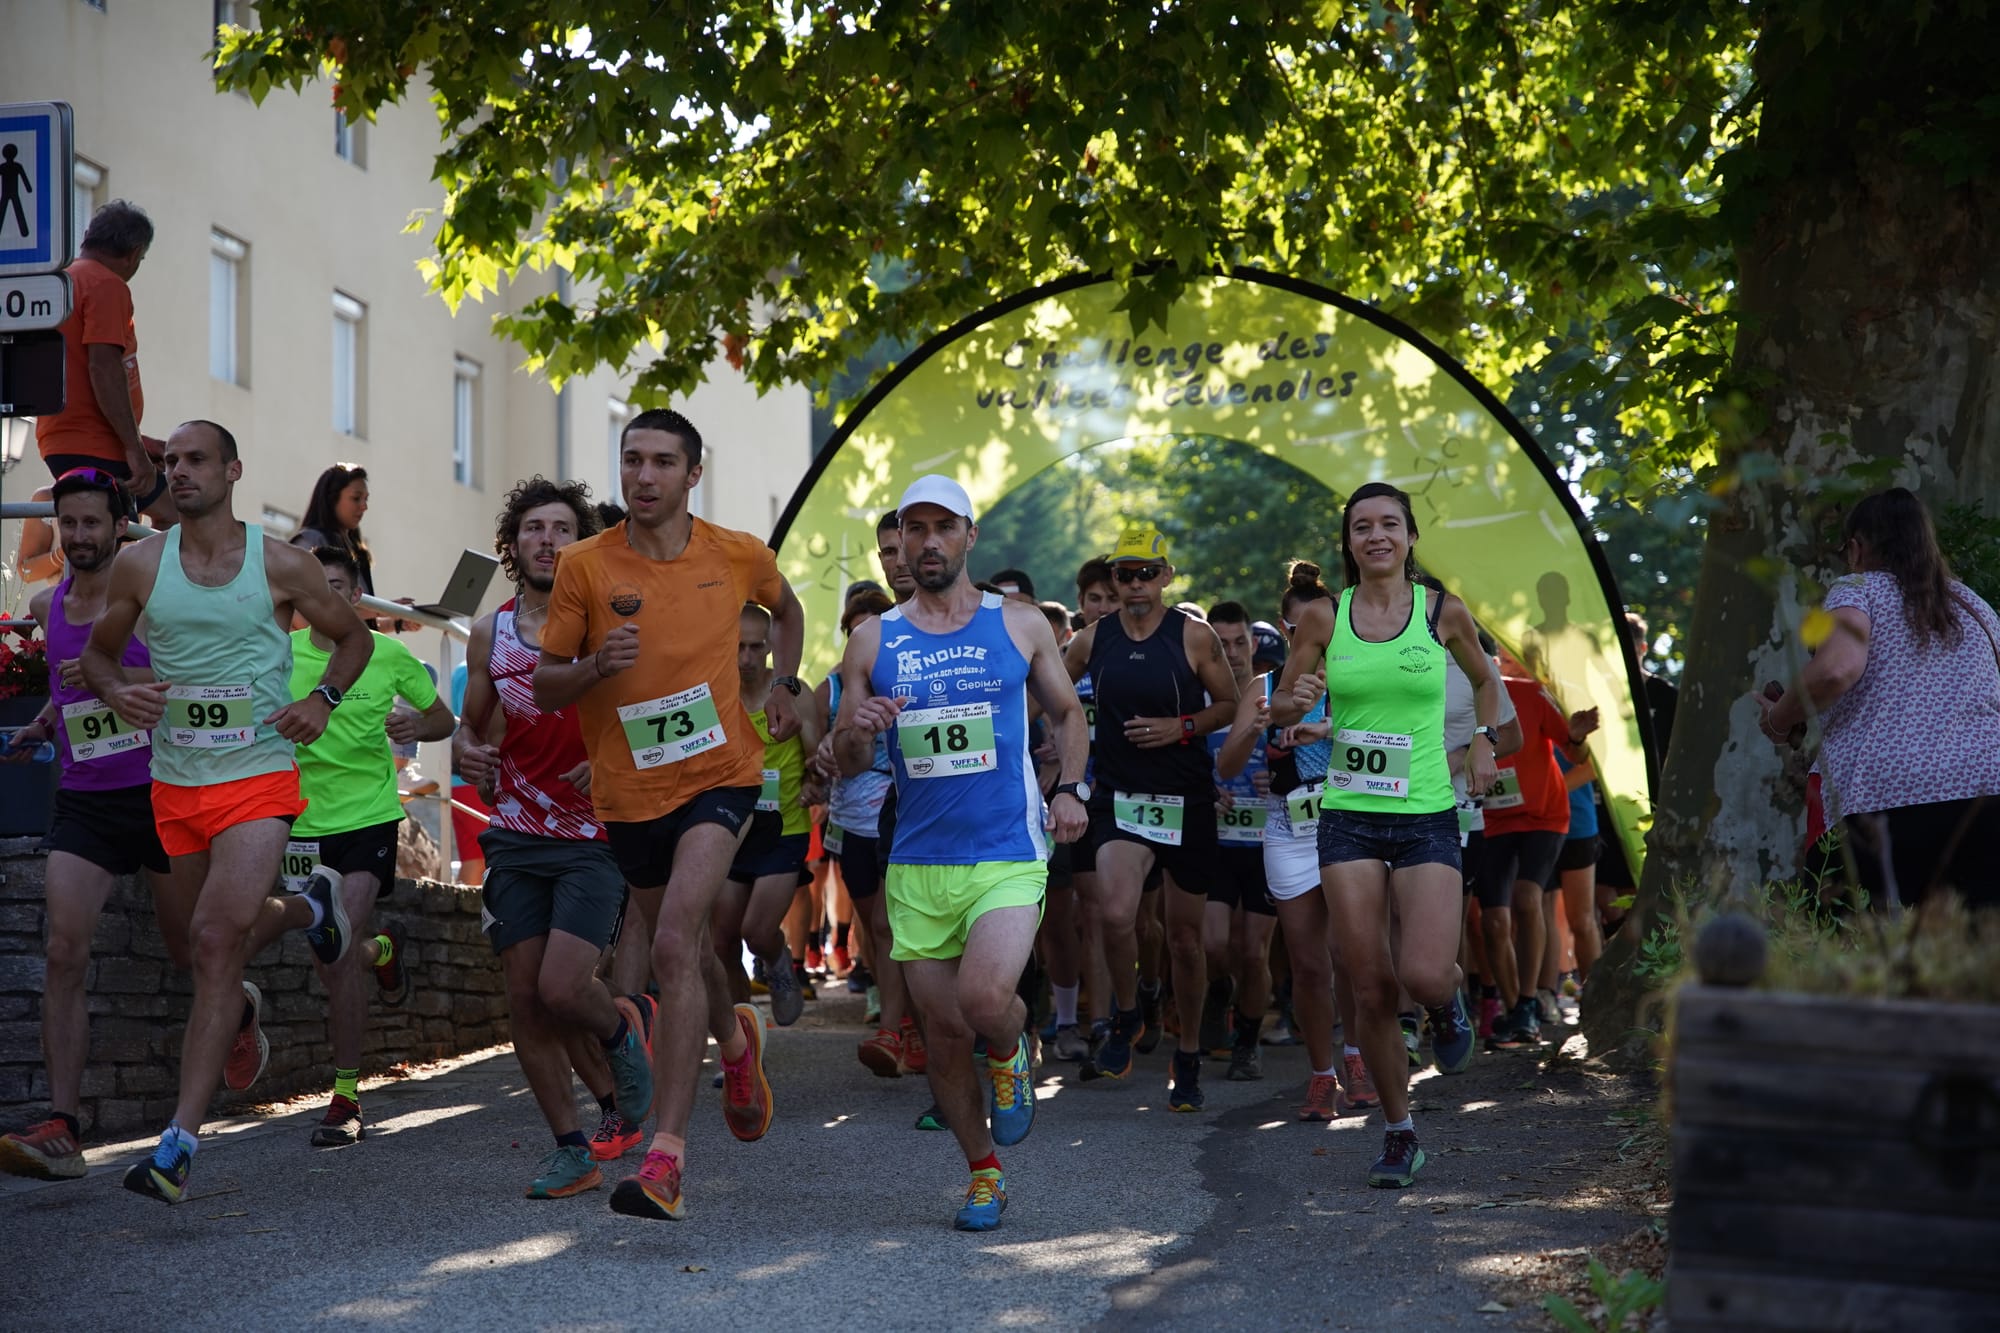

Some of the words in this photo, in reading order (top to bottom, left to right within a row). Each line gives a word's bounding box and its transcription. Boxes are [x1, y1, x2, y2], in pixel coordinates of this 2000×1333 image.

[0, 290, 25, 318] 0
[31, 300, 51, 316] m
[1003, 337, 1224, 378] Challenge
[1257, 331, 1331, 361] des
[1163, 370, 1358, 407] cévenoles
[83, 712, 118, 739] 91
[188, 703, 228, 727] 99
[647, 711, 694, 742] 73
[680, 737, 707, 751] TUFF'S
[924, 724, 968, 753] 18
[950, 758, 978, 766] TUFF'S
[1347, 747, 1387, 774] 90
[1366, 780, 1391, 788] TUFF'S
[1133, 805, 1164, 827] 13
[1224, 809, 1253, 827] 66
[1301, 798, 1322, 818] 1
[283, 855, 312, 875] 108
